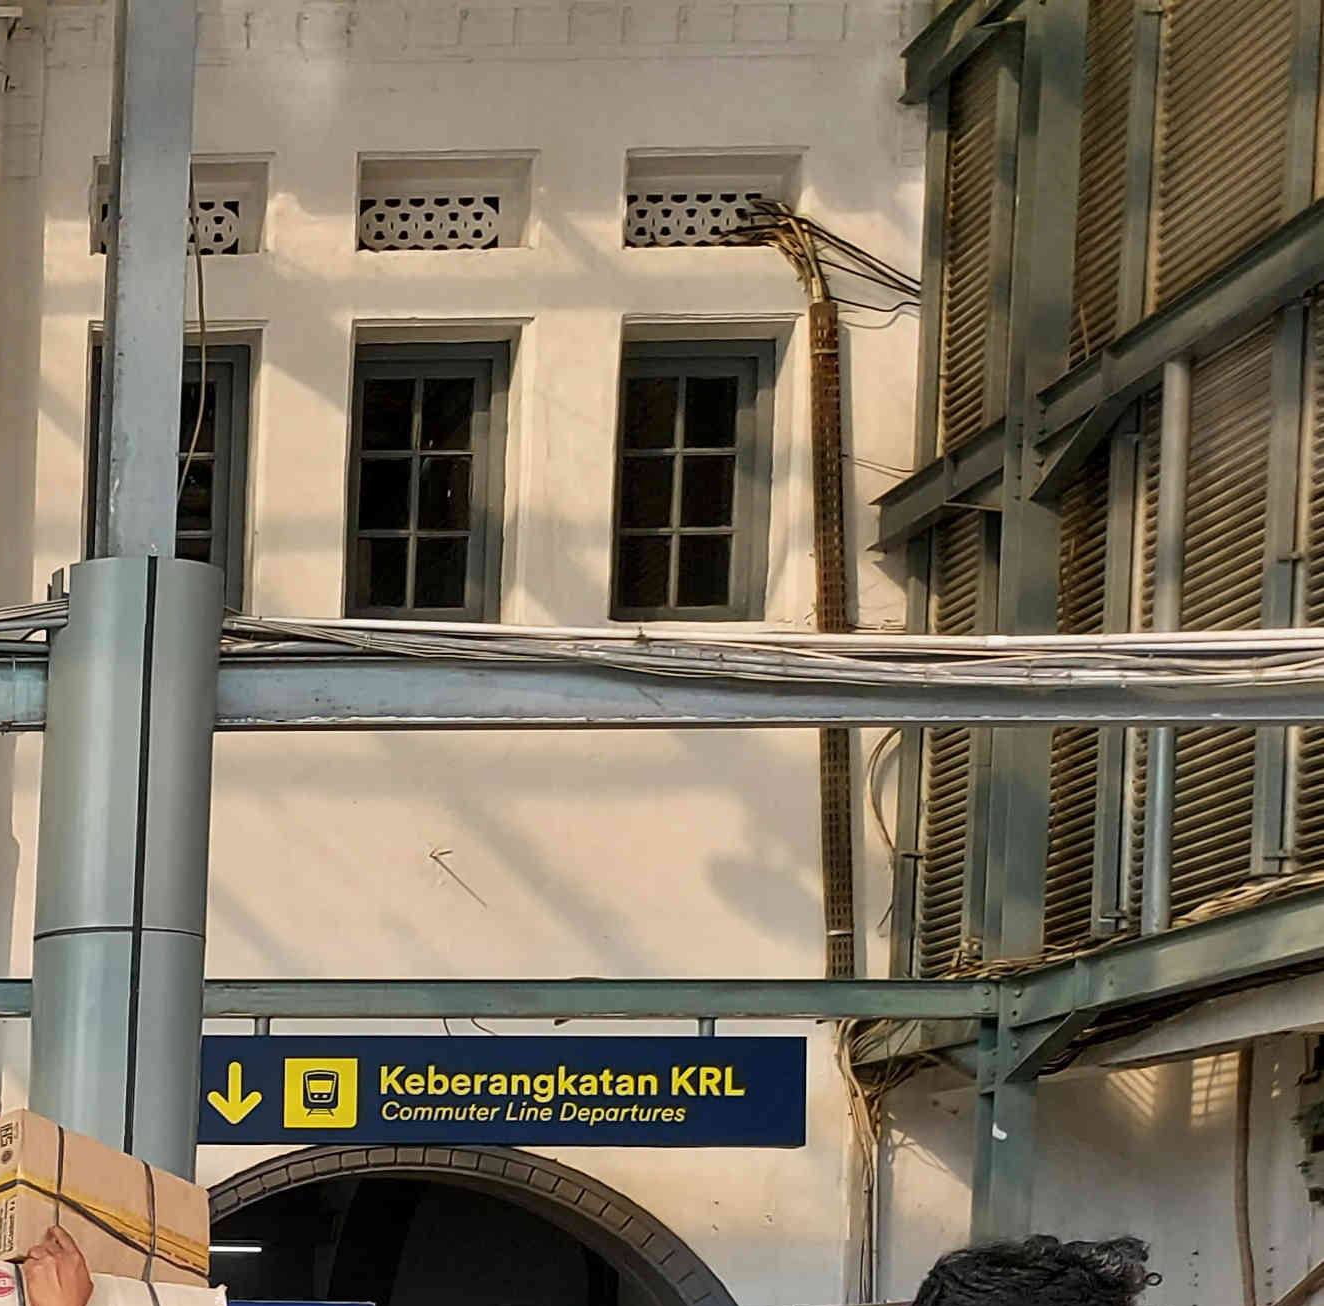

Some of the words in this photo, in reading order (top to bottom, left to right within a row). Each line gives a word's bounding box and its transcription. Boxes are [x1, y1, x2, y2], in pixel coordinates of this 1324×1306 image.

[380, 1065, 657, 1101] Keberangkatan
[671, 1066, 745, 1097] KRL
[381, 1101, 499, 1122] Commuter
[506, 1101, 553, 1122] Line
[559, 1101, 687, 1126] Departures
